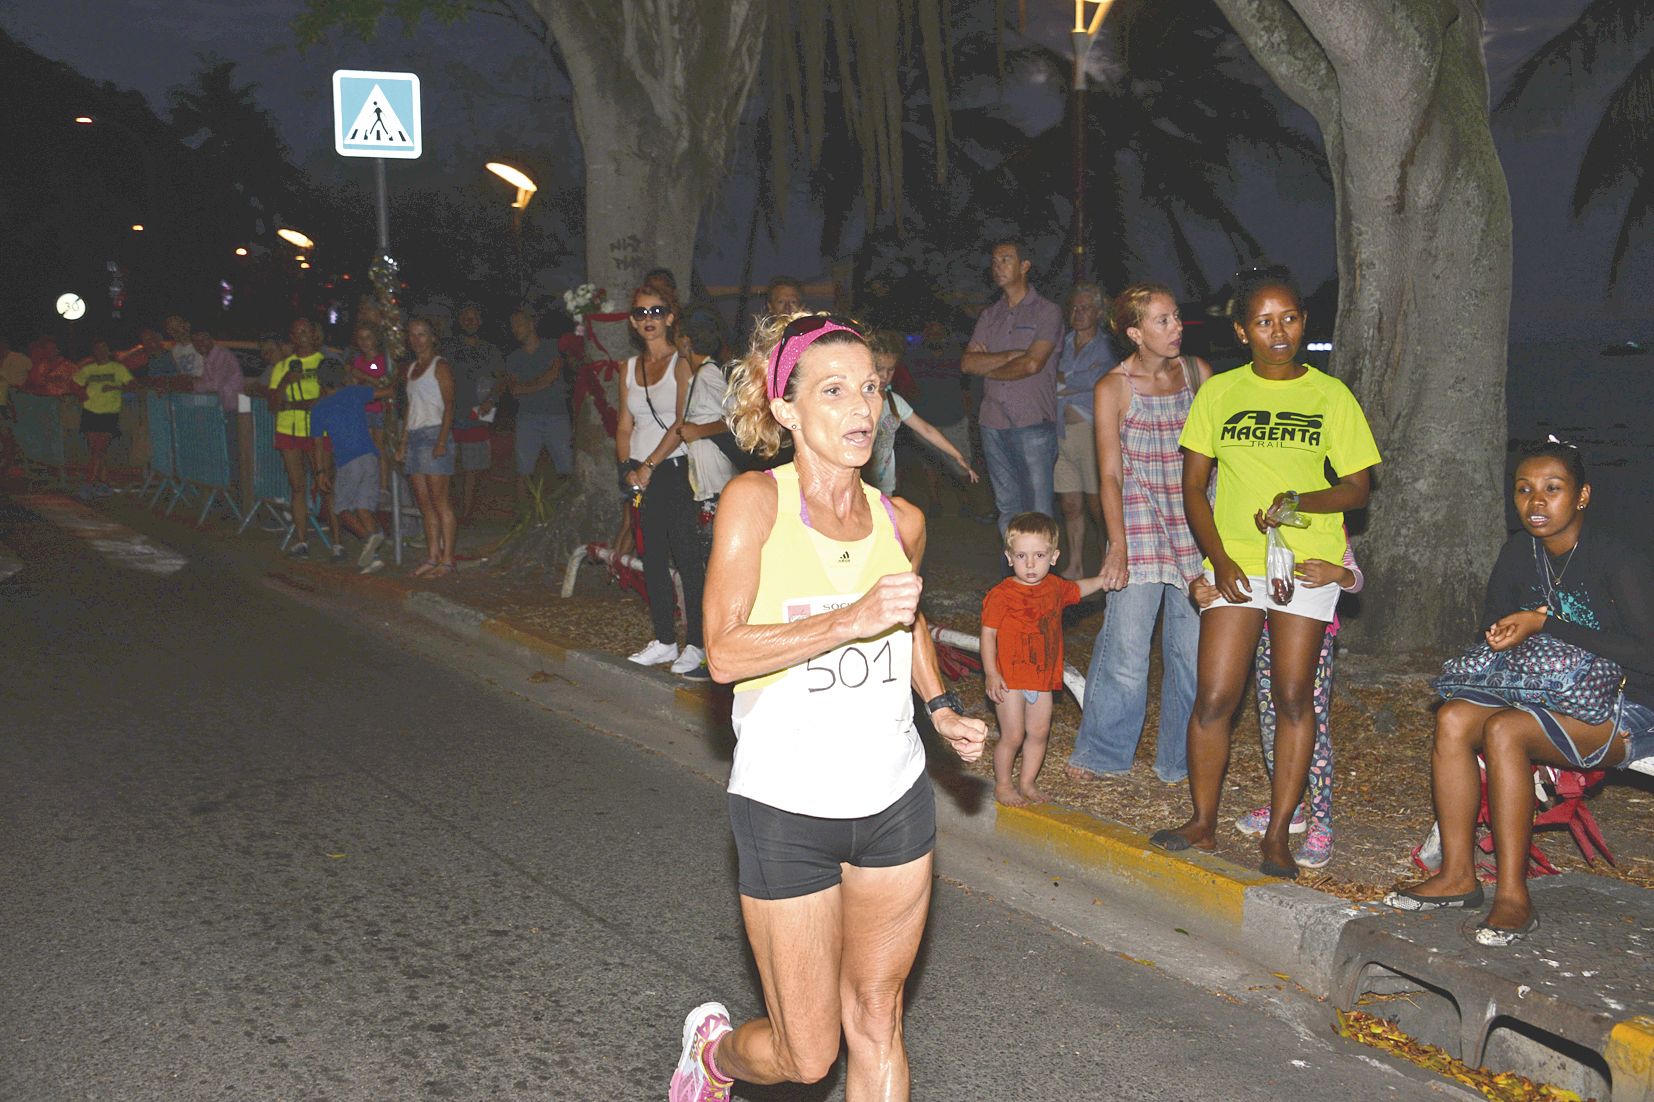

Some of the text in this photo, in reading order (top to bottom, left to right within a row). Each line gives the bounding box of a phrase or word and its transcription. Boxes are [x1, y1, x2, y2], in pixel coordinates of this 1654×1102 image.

[1223, 410, 1324, 430] AS
[1220, 426, 1321, 446] MAGENTA
[1249, 440, 1285, 449] TRAIL
[822, 602, 853, 611] SOC
[806, 640, 898, 693] 501
